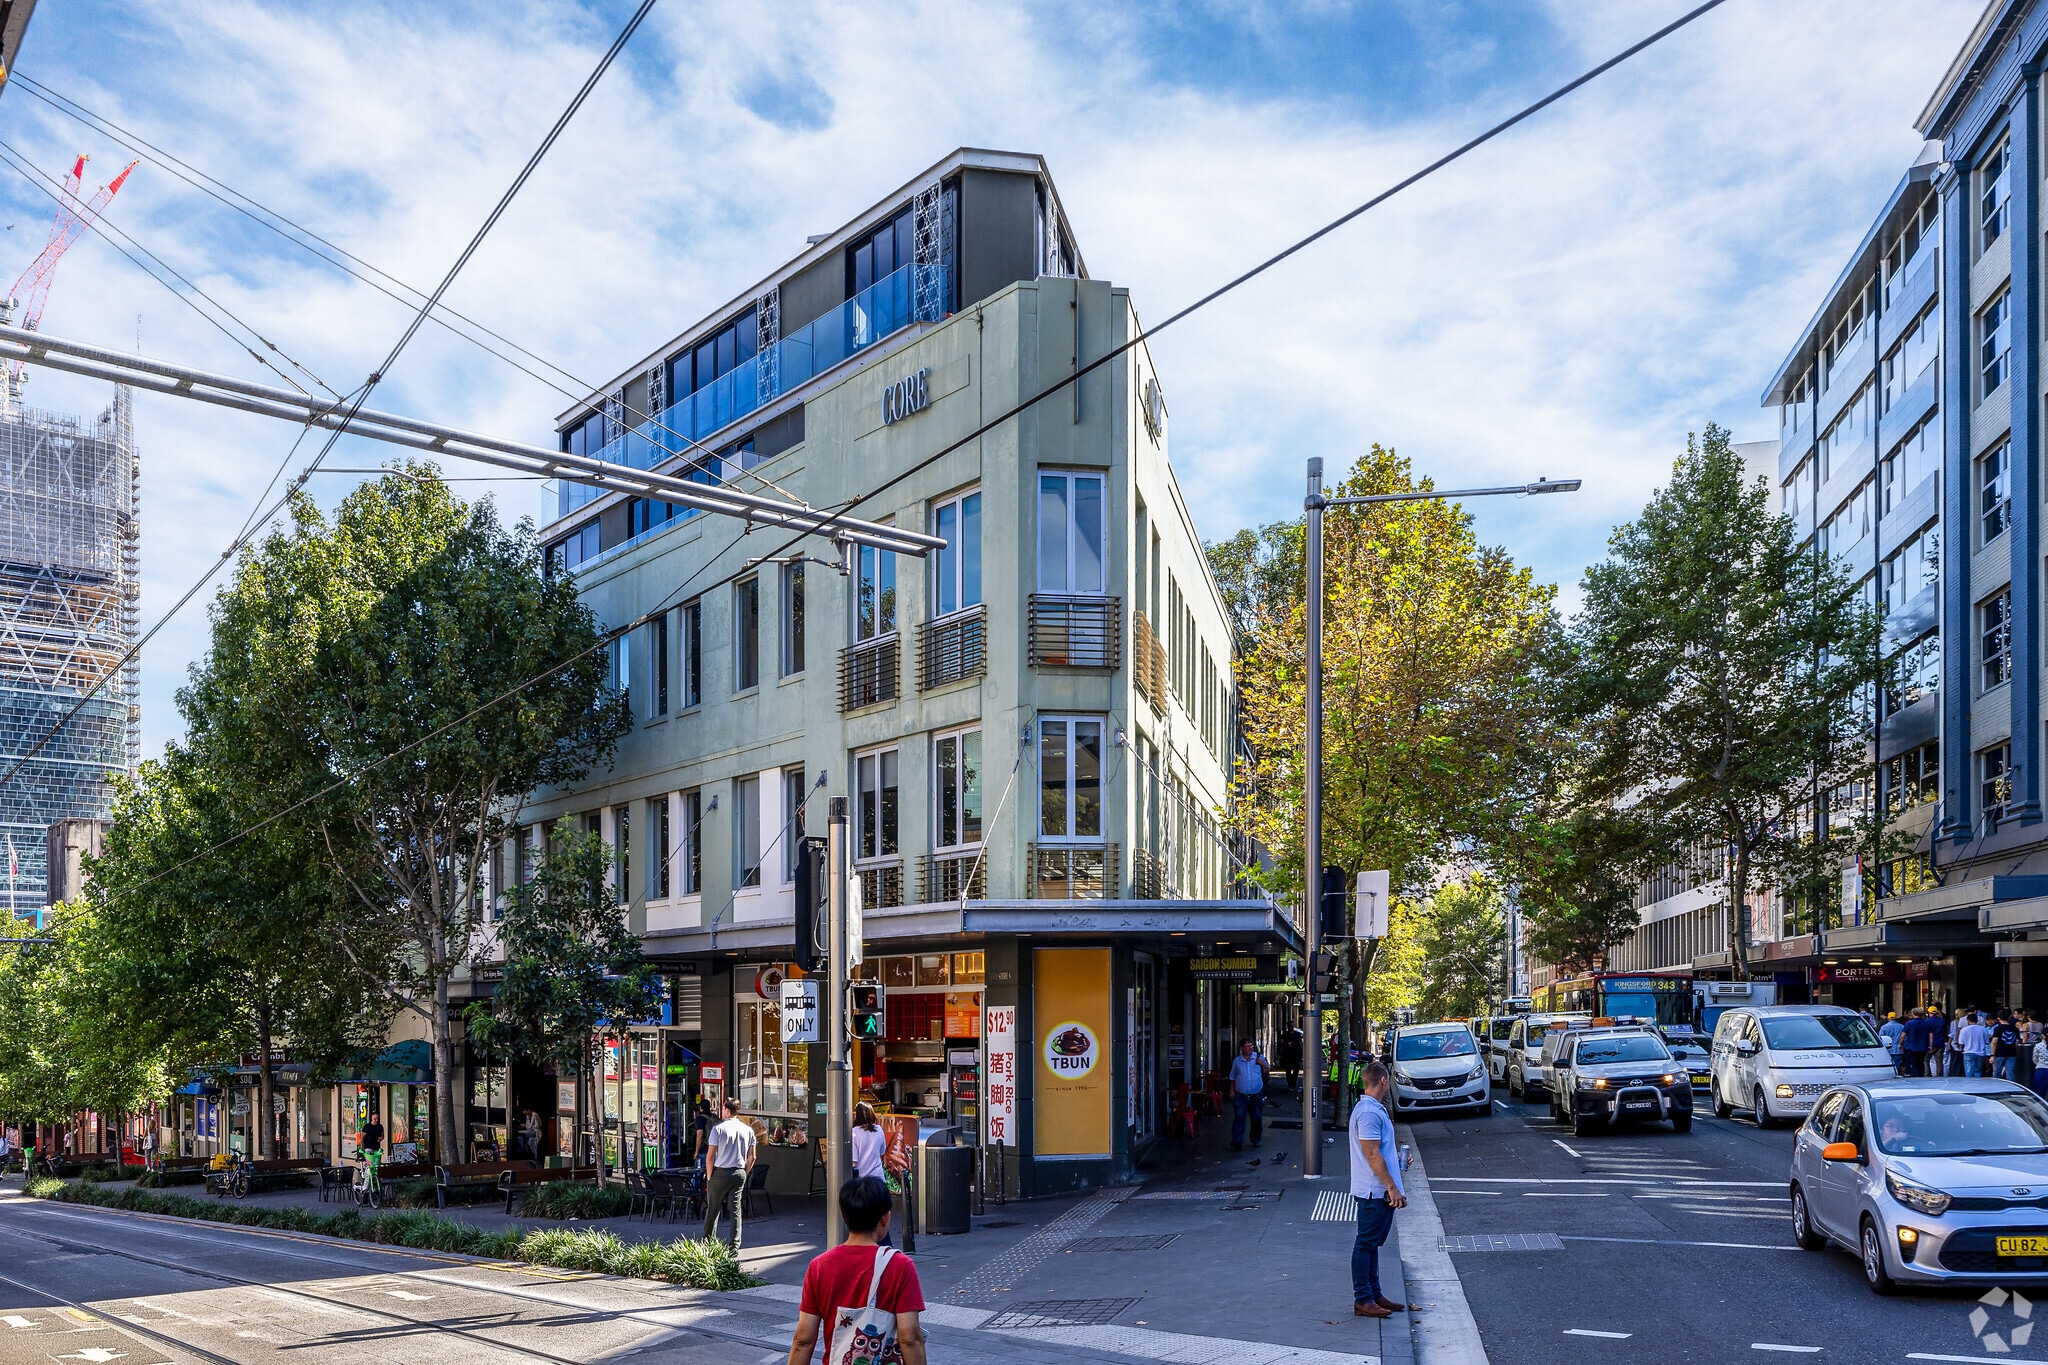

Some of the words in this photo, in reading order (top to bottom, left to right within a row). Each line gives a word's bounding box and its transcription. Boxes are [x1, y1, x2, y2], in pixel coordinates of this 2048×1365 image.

[881, 368, 929, 426] CORE
[1190, 958, 1220, 971] SAIGON
[1221, 957, 1257, 970] SUMMER
[1835, 968, 1884, 976] PORTERS
[1657, 981, 1676, 990] 343
[787, 1018, 814, 1032] ONLY
[988, 1011, 1014, 1035] $12.90
[1005, 1052, 1014, 1082] Pork
[1051, 1057, 1090, 1070] TBUN
[990, 1052, 1004, 1139] 猪脚饭
[1005, 1086, 1014, 1114] Rice
